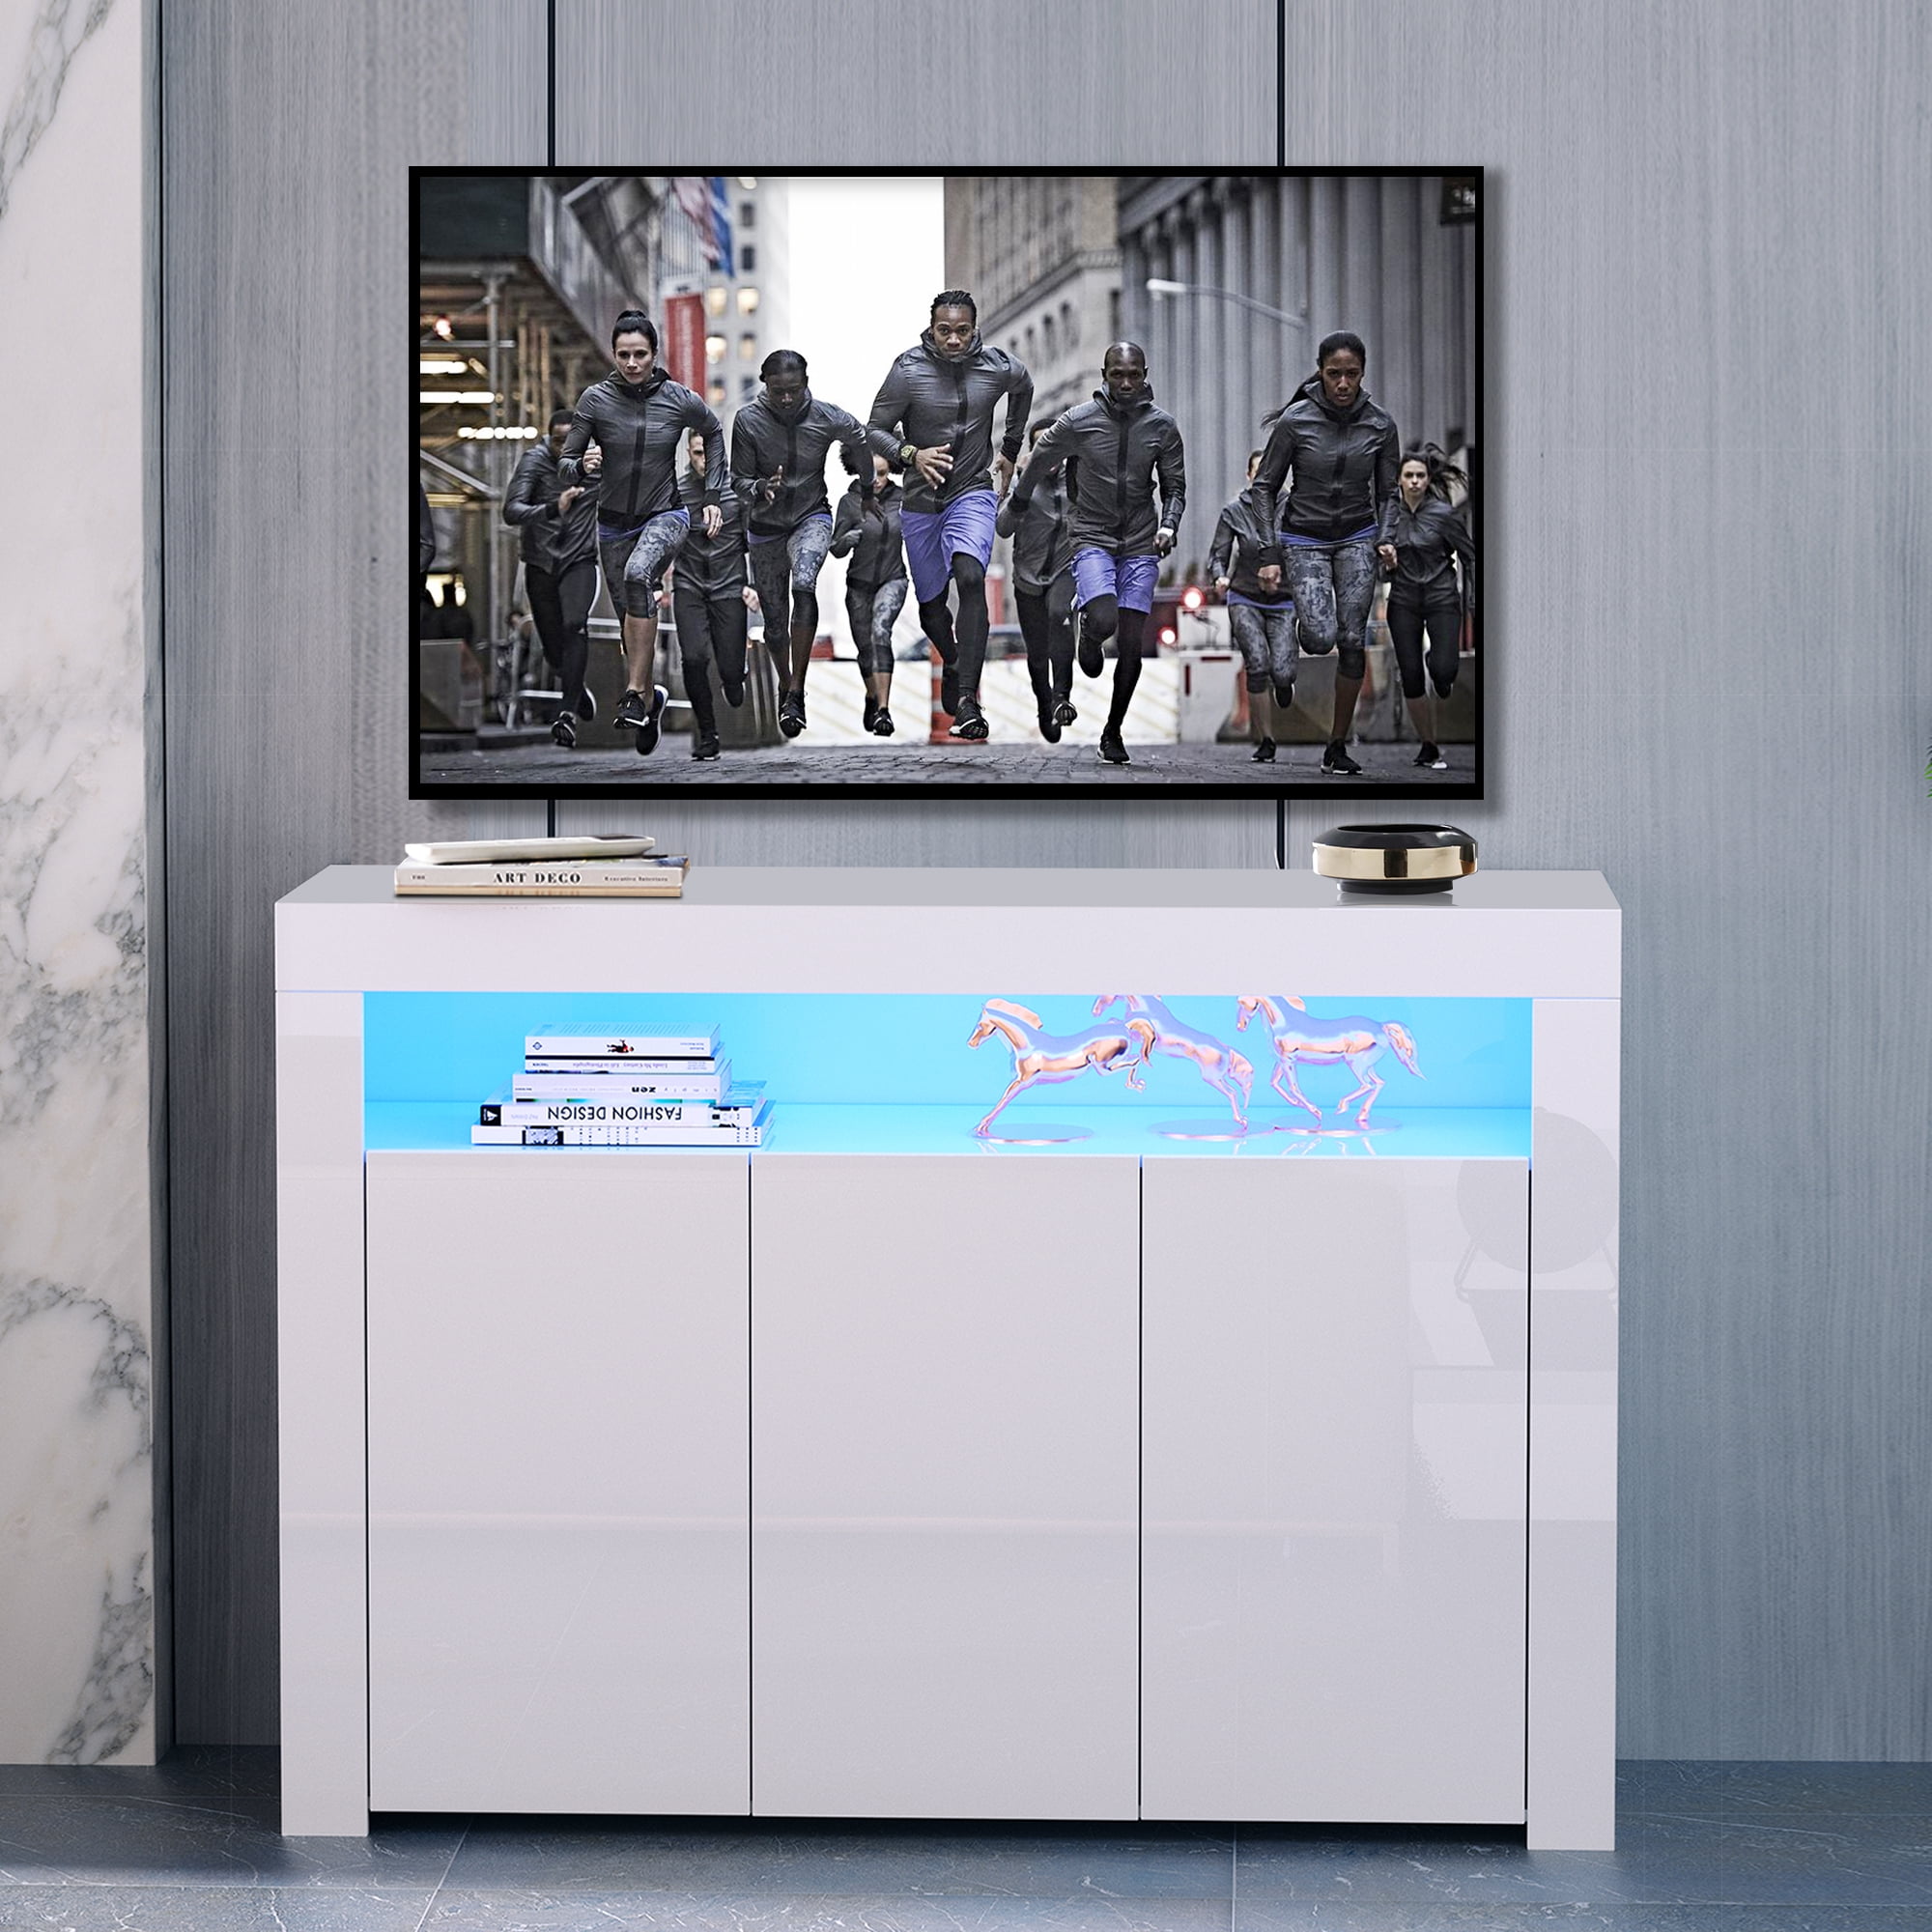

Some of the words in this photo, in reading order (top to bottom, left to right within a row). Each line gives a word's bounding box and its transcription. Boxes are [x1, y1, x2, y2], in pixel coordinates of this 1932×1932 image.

[493, 872, 527, 884] ART
[534, 872, 582, 884] DECO
[547, 1106, 607, 1121] DESIGN
[611, 1106, 682, 1121] FASHION
